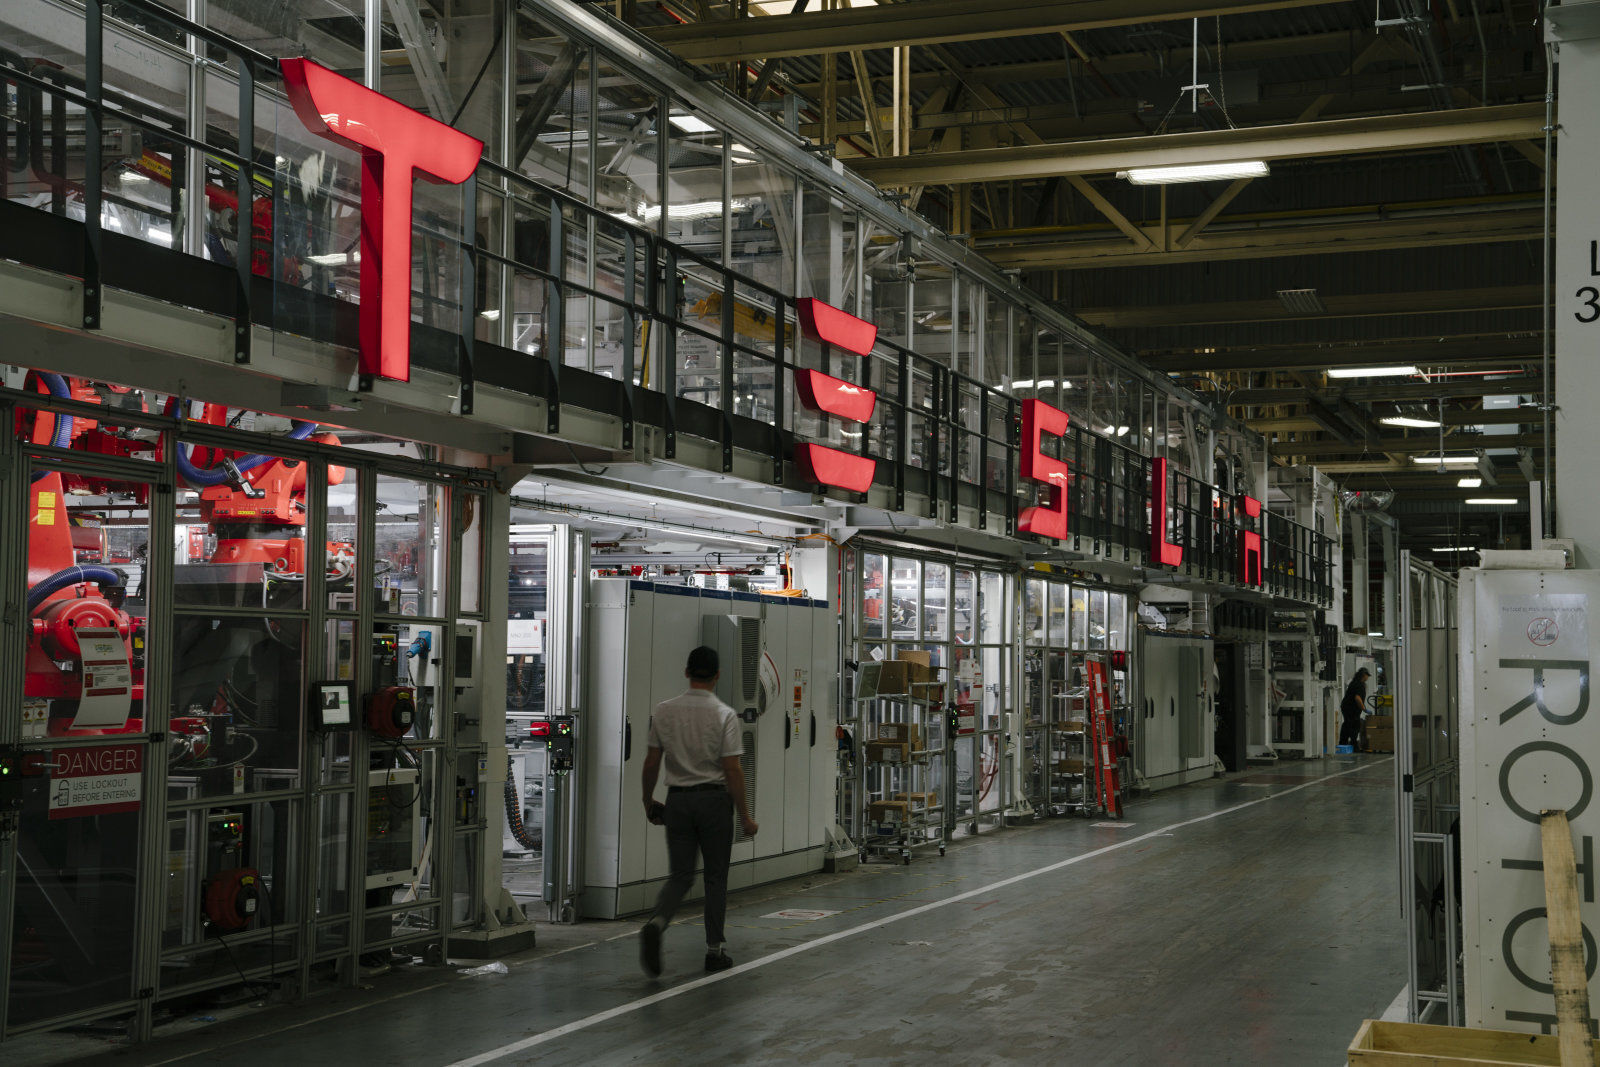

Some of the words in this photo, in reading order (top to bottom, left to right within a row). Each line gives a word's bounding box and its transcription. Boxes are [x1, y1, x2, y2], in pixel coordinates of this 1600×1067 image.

[280, 57, 1262, 588] TESLA
[57, 750, 136, 774] DANGER
[73, 781, 88, 790] USE
[92, 779, 127, 789] LOCKOUT
[72, 793, 100, 802] BEFORE
[103, 789, 136, 800] ENTERING
